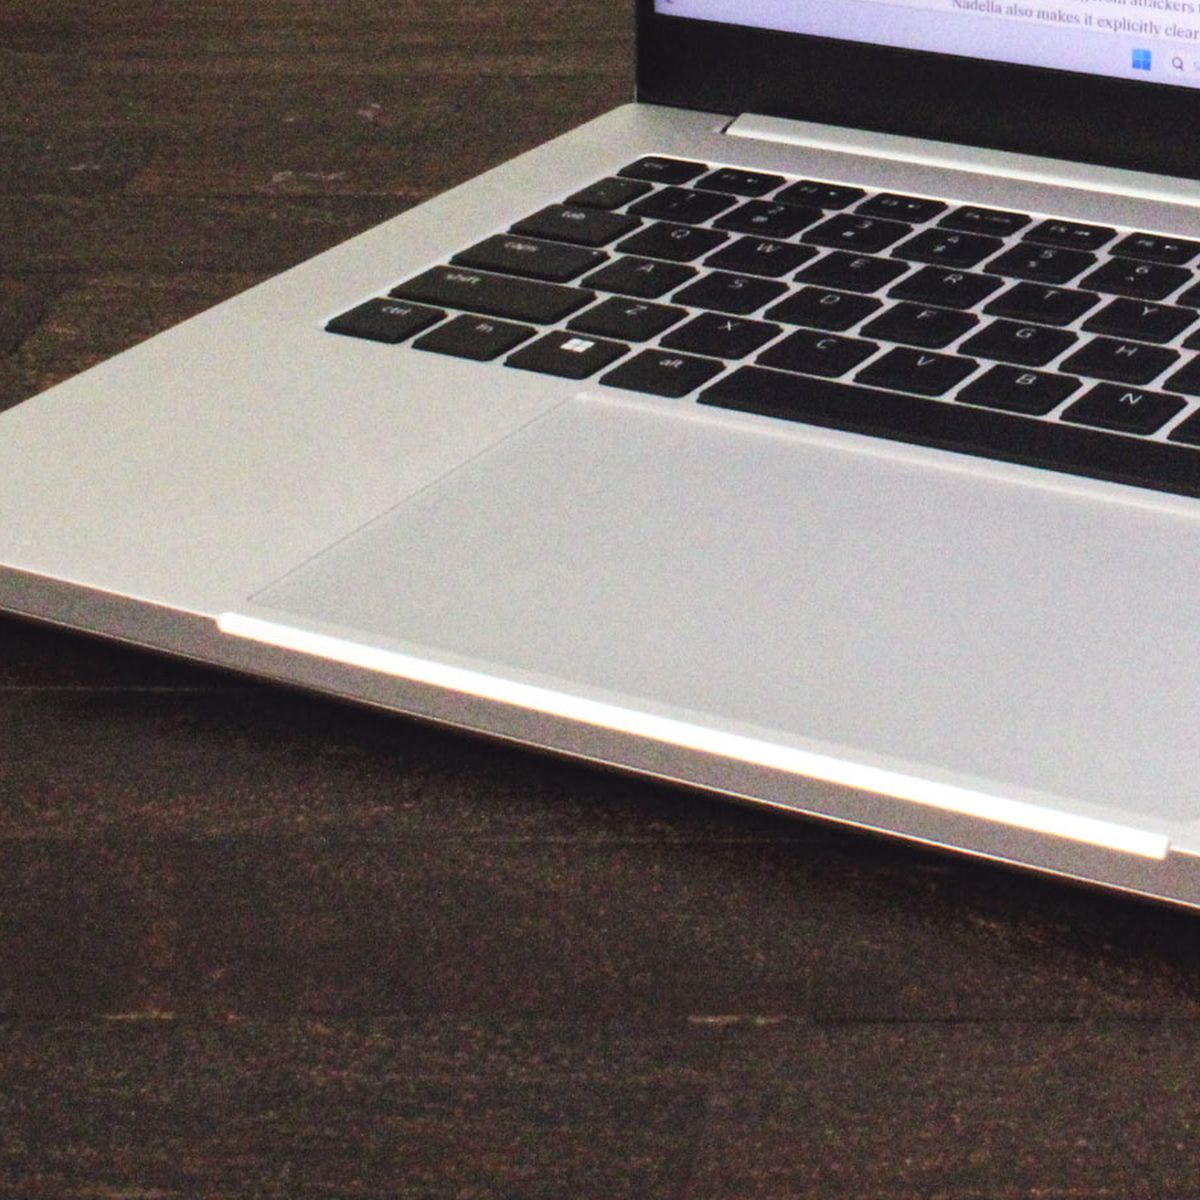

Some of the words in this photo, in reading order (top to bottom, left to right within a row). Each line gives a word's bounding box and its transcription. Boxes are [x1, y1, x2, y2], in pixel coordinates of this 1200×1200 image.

[1005, 3, 1033, 18] also
[1036, 9, 1080, 24] makes
[1083, 13, 1092, 26] it
[1096, 17, 1161, 38] explicitly
[1164, 24, 1200, 40] clear
[1120, 392, 1142, 405] N
